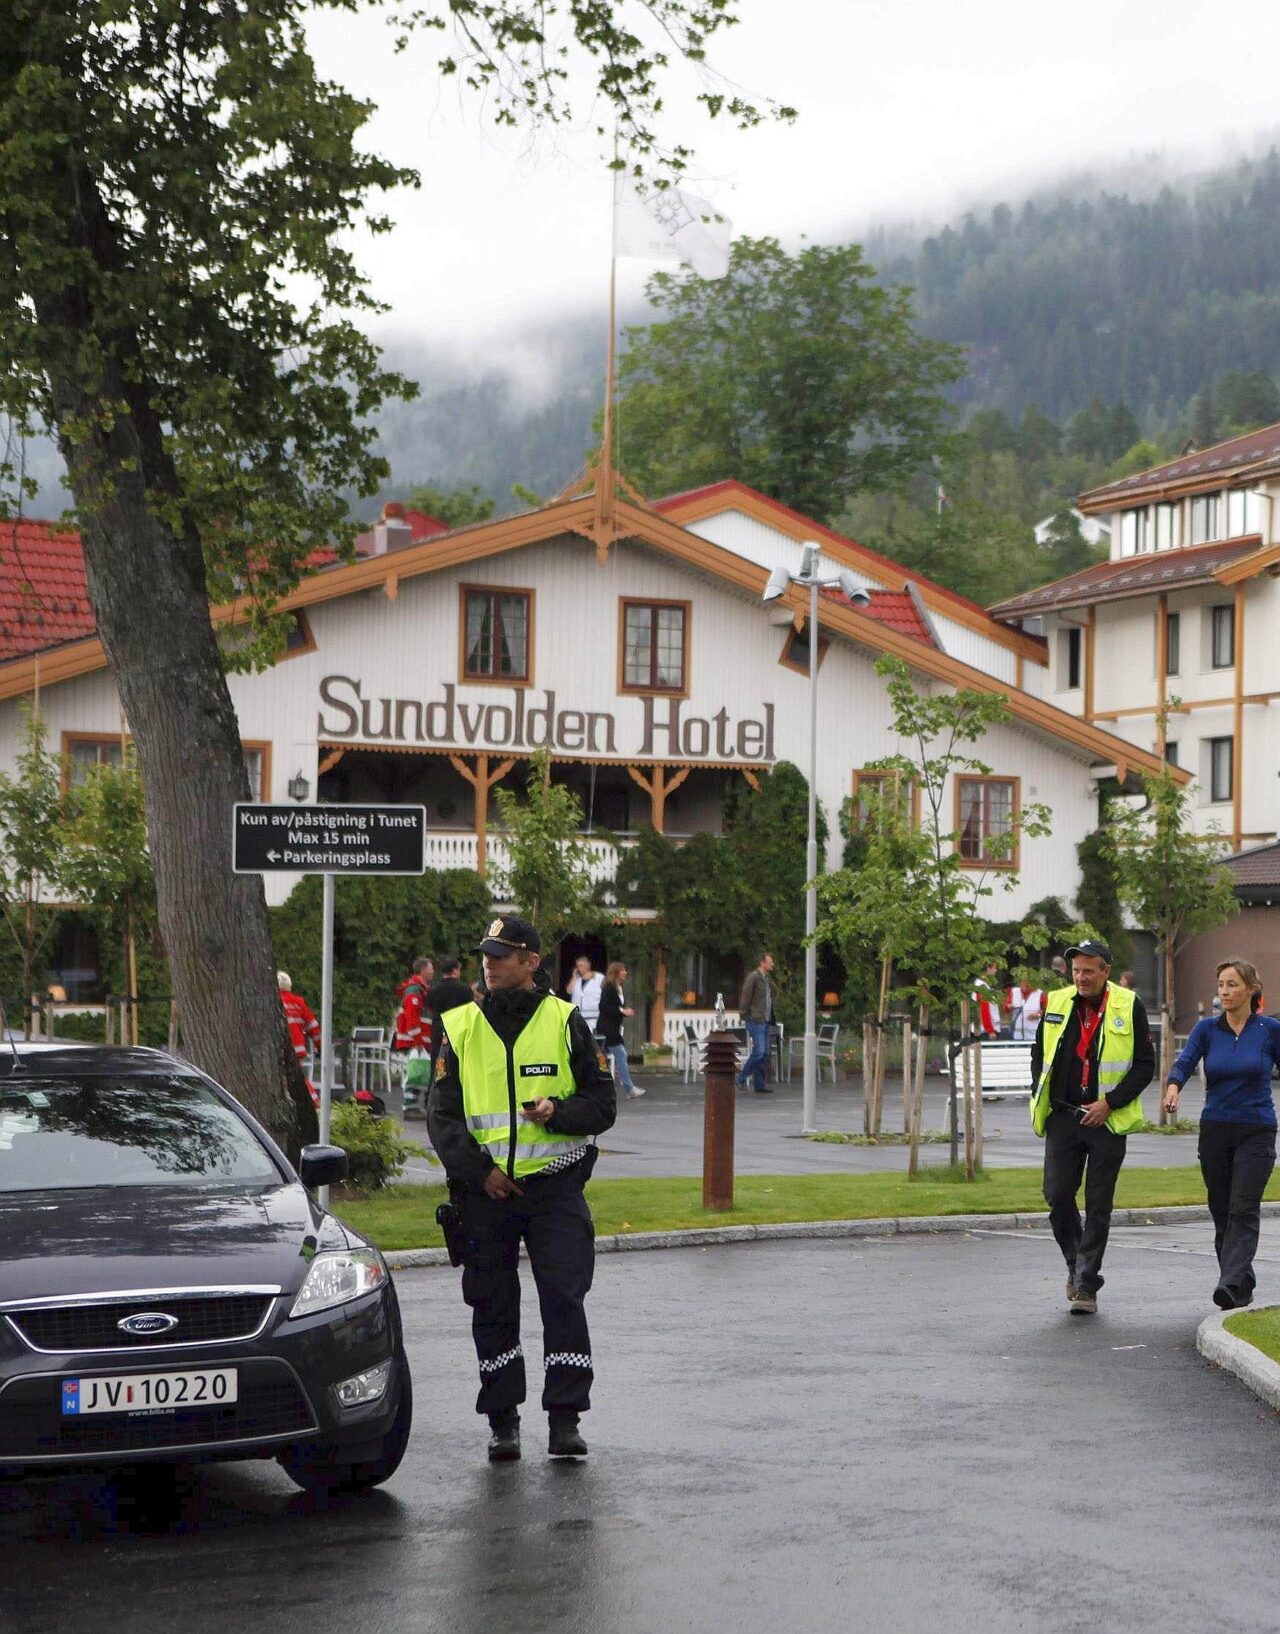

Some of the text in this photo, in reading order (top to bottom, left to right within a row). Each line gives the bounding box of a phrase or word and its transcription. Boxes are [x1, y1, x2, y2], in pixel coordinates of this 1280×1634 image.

[317, 674, 777, 761] Sundvolden Hotel
[240, 812, 418, 829] Kun av/påstigning i Tunet
[288, 832, 370, 845] Max 15 min
[283, 850, 391, 867] Parkeringsplass
[525, 1066, 551, 1075] POLITI
[135, 1317, 162, 1329] Ford
